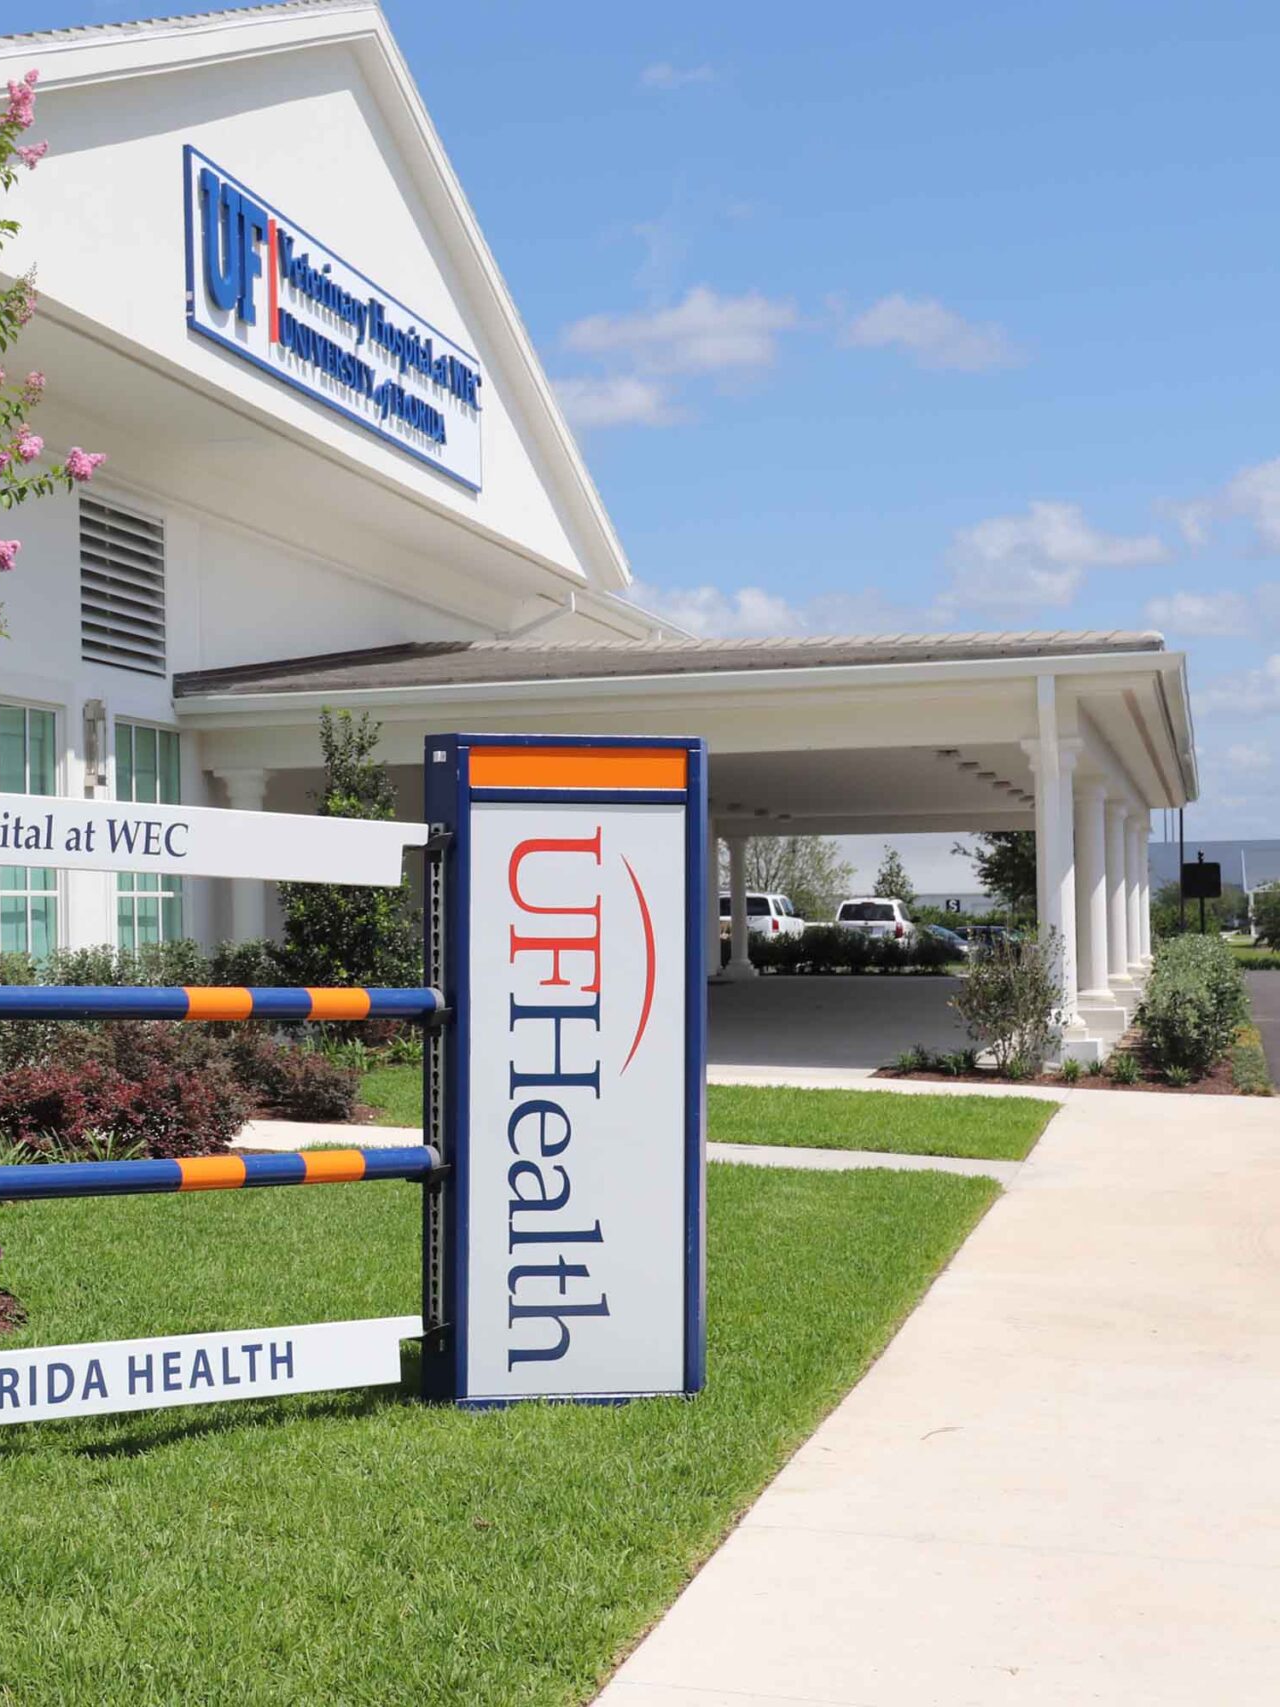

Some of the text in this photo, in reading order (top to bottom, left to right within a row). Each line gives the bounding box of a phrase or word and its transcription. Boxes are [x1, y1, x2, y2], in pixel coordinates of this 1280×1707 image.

[199, 167, 268, 326] UF
[277, 227, 369, 345] Veterinary
[368, 298, 432, 374] Hospital
[277, 307, 375, 399] UNIVERSITY
[389, 383, 447, 444] FLORIDA
[65, 820, 96, 853] at
[107, 818, 190, 858] WEC
[128, 1341, 295, 1394] HEALTH
